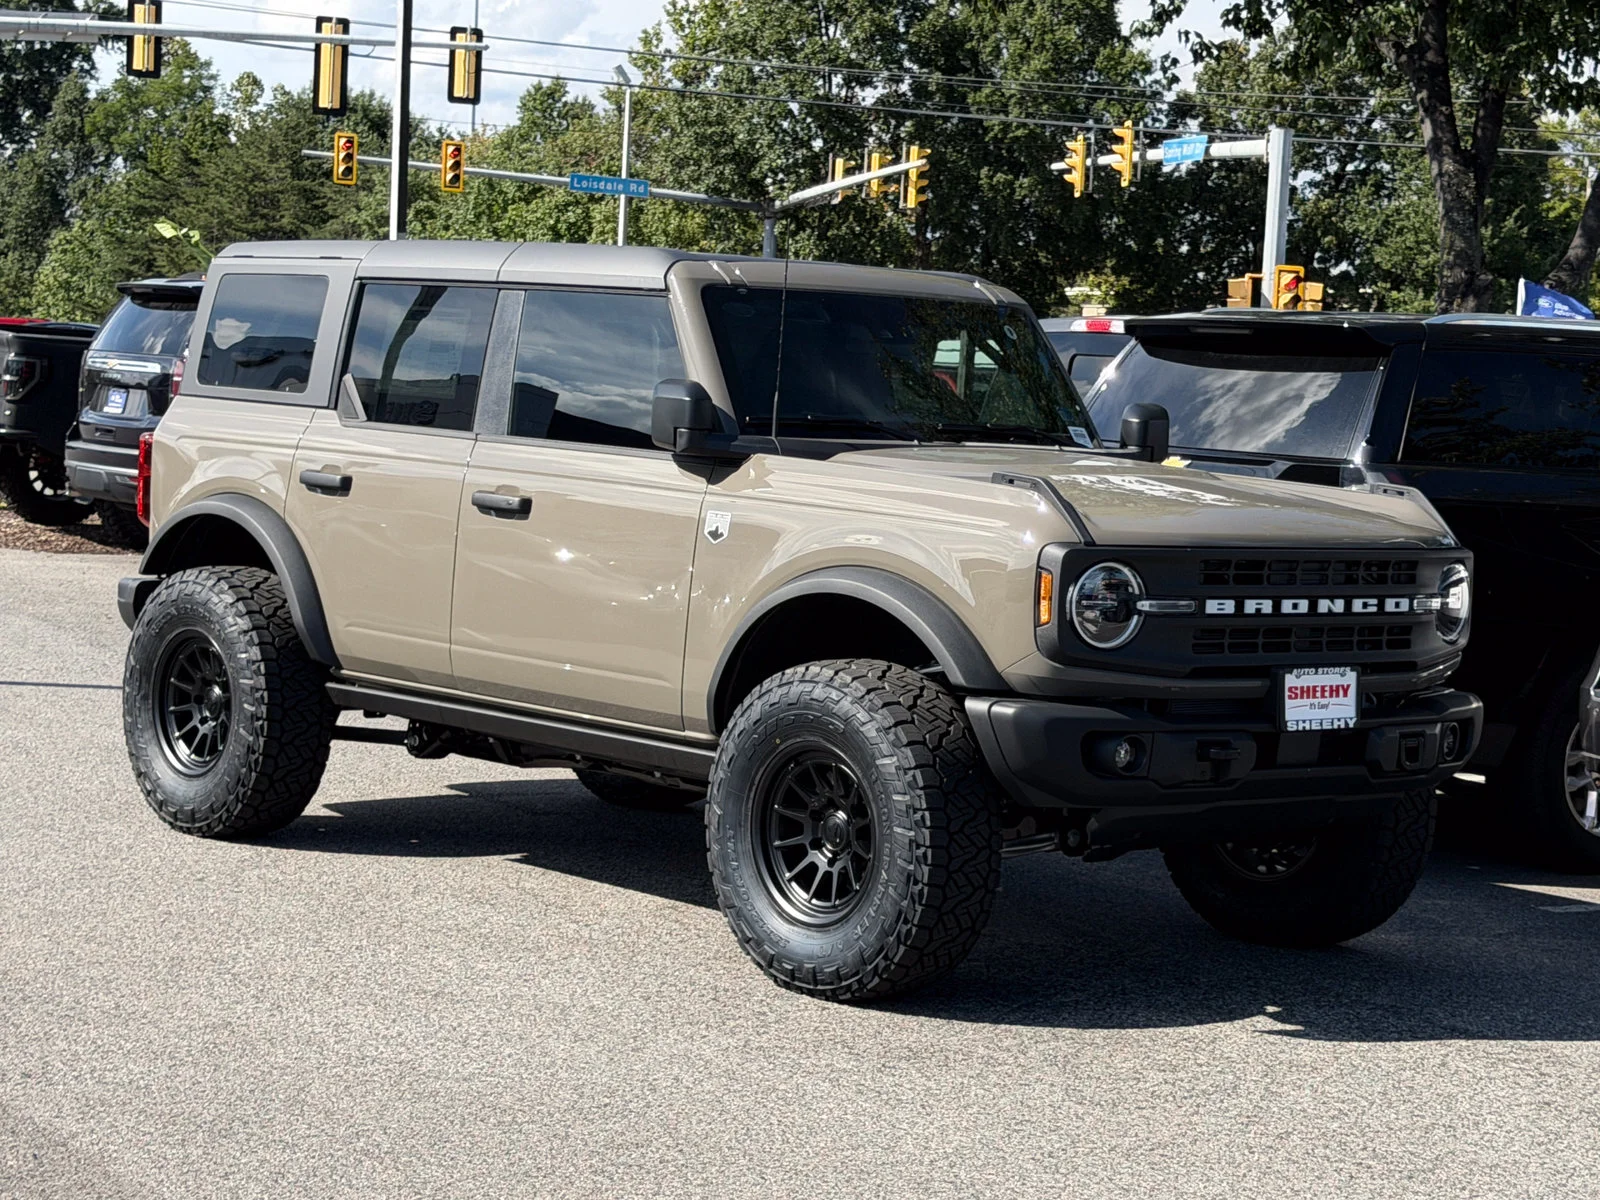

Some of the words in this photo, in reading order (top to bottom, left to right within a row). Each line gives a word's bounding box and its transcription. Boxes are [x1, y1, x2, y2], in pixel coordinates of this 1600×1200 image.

[573, 178, 624, 191] Loisdale
[629, 183, 645, 193] Rd
[1204, 598, 1410, 614] BRONCO
[1291, 668, 1316, 676] AUTO
[1317, 666, 1351, 676] STORES
[1287, 684, 1352, 700] SHEEHY
[1317, 701, 1331, 711] Easy!
[1286, 717, 1357, 732] SHEEHY
[853, 842, 891, 941] GRAPPLER
